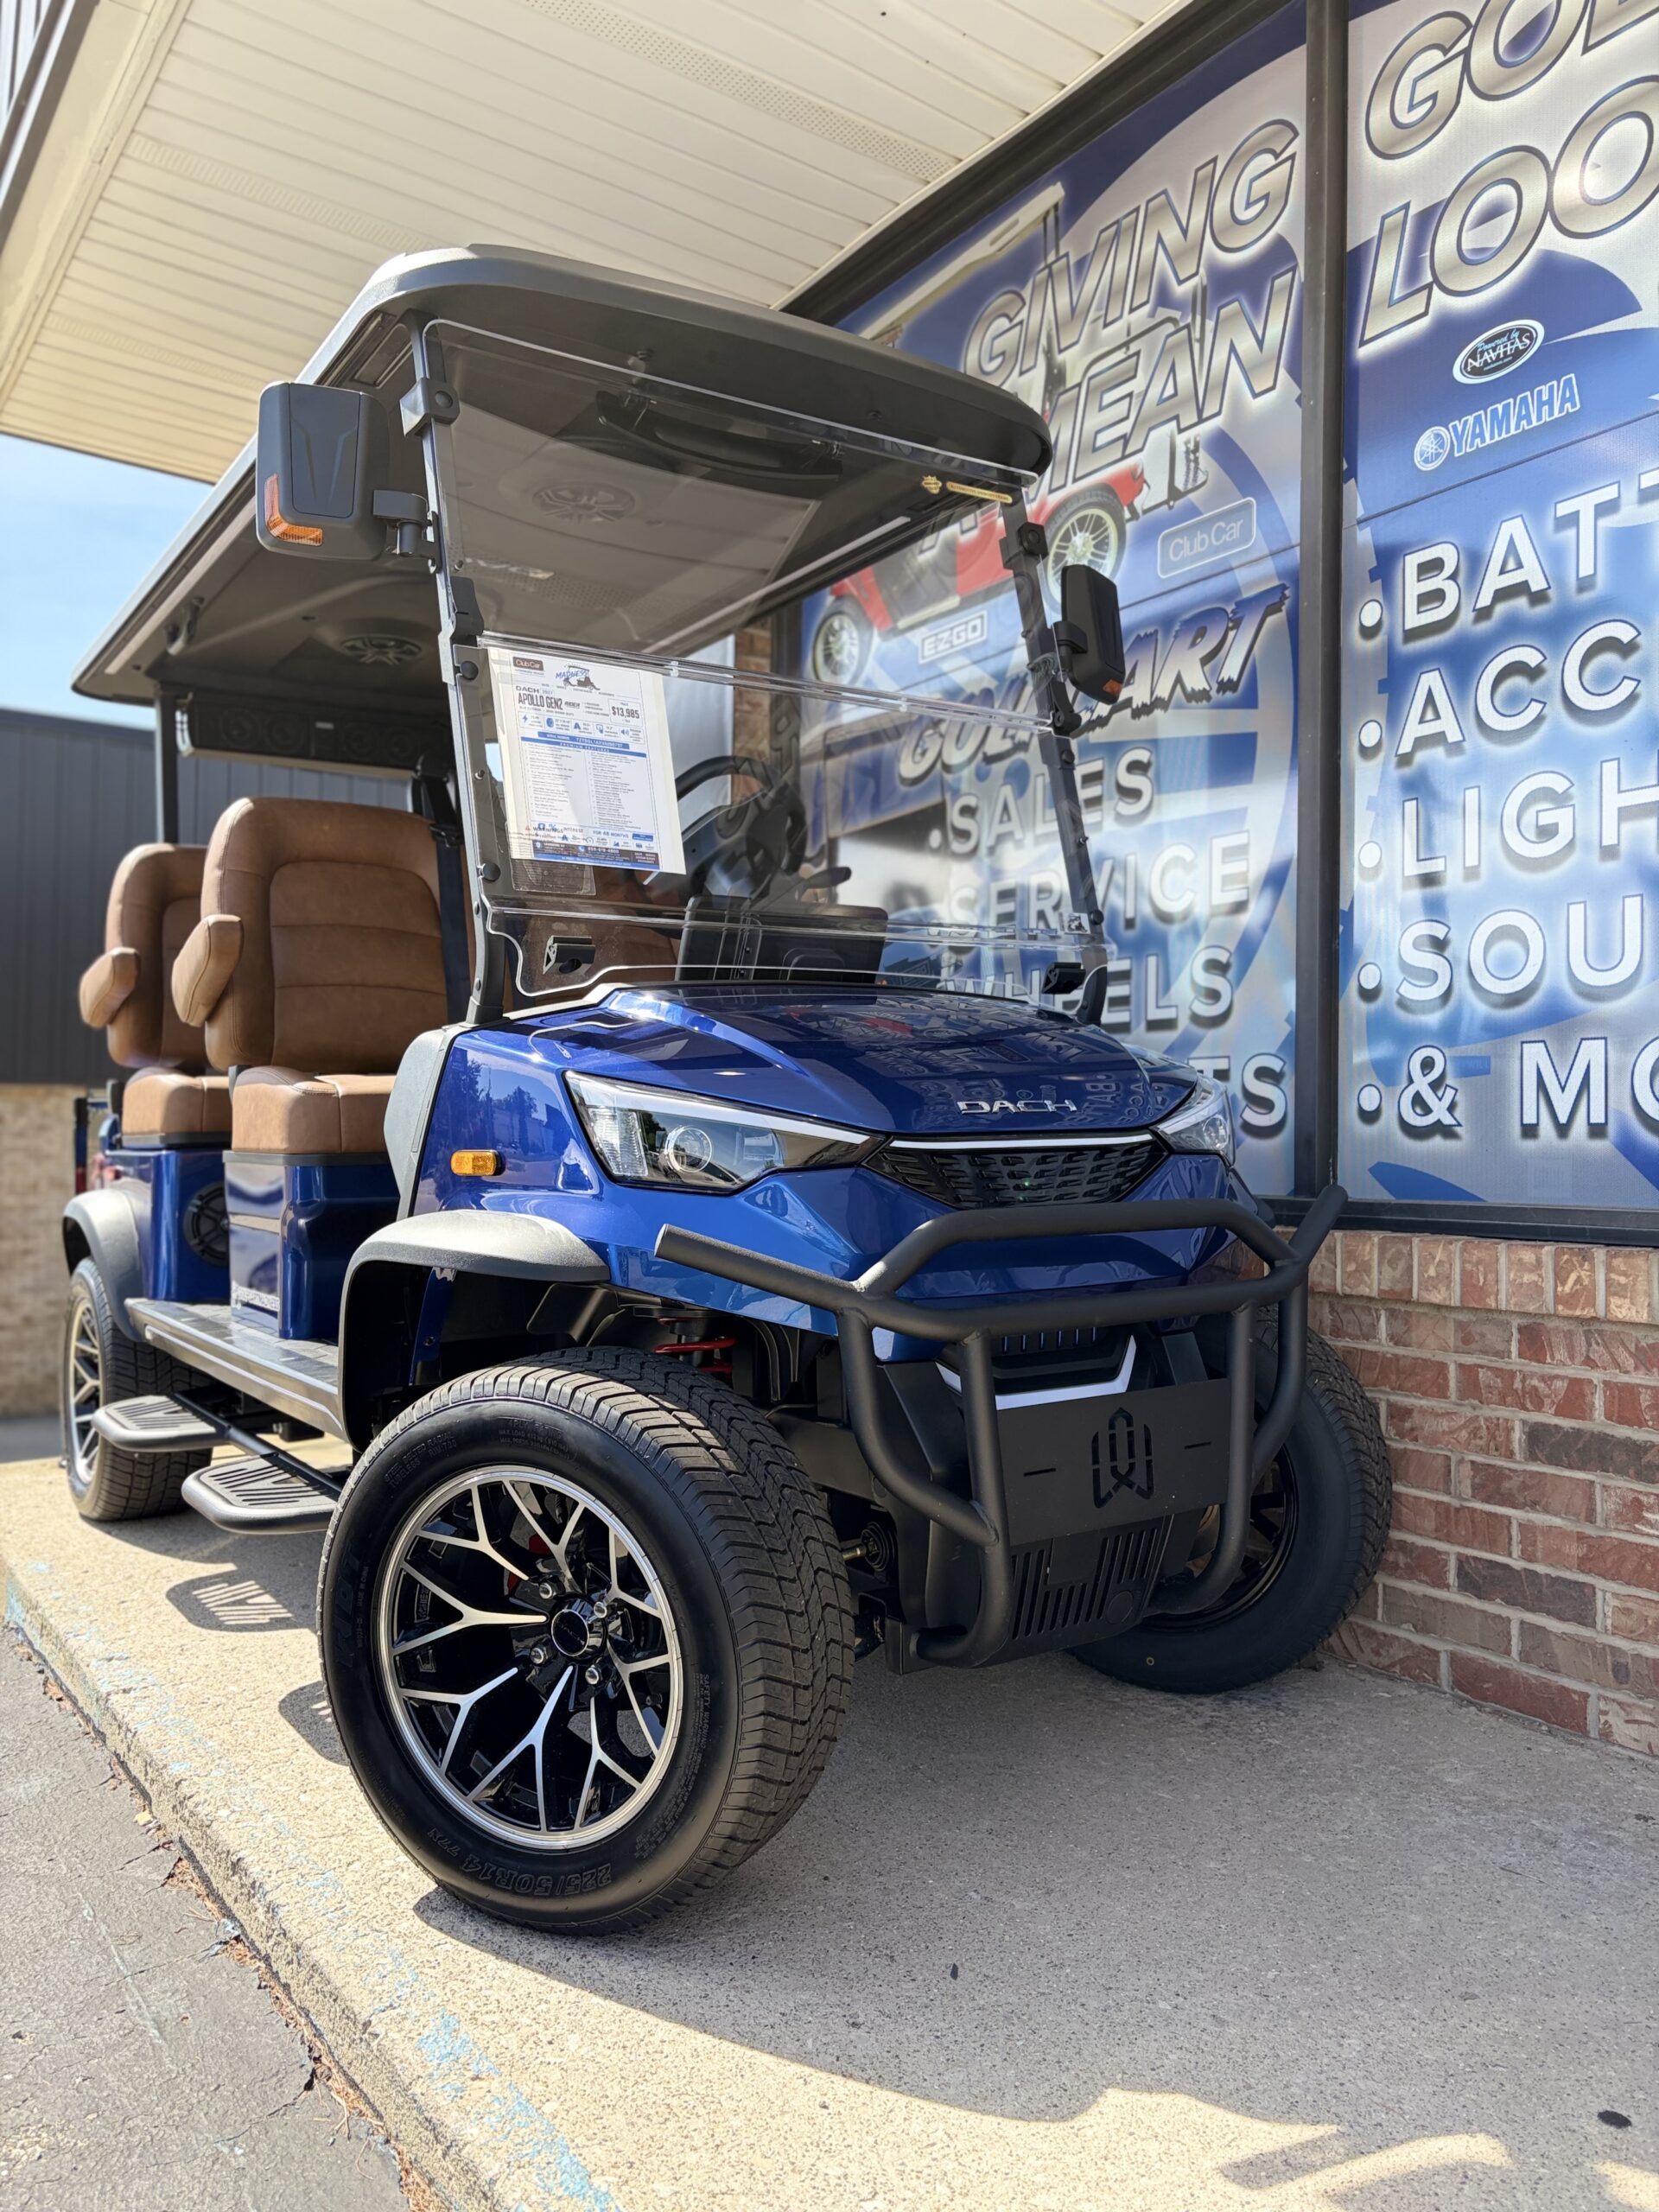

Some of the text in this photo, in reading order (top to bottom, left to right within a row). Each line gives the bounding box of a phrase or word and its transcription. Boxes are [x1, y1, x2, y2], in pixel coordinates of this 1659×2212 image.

[965, 118, 1300, 388] GIVING
[1466, 333, 1531, 372] NAVITAS
[1477, 328, 1521, 351] Powered by
[1448, 373, 1580, 457] YAMAHA
[1169, 518, 1243, 562] Club Car
[1402, 467, 1659, 632] BAT
[923, 617, 983, 658] EZGO
[518, 693, 544, 707] APOLLO
[545, 696, 563, 710] GEN2
[899, 583, 1290, 783] GOL ART
[1395, 619, 1642, 758] ACC
[612, 706, 640, 719] $13,985
[950, 747, 1154, 854] SALES
[1395, 893, 1643, 1001] SOU
[957, 1099, 1077, 1115] DACH
[1398, 1045, 1462, 1127] &
[427, 1432, 454, 1446] RADIAL
[461, 1854, 613, 1896] 225/50R14
